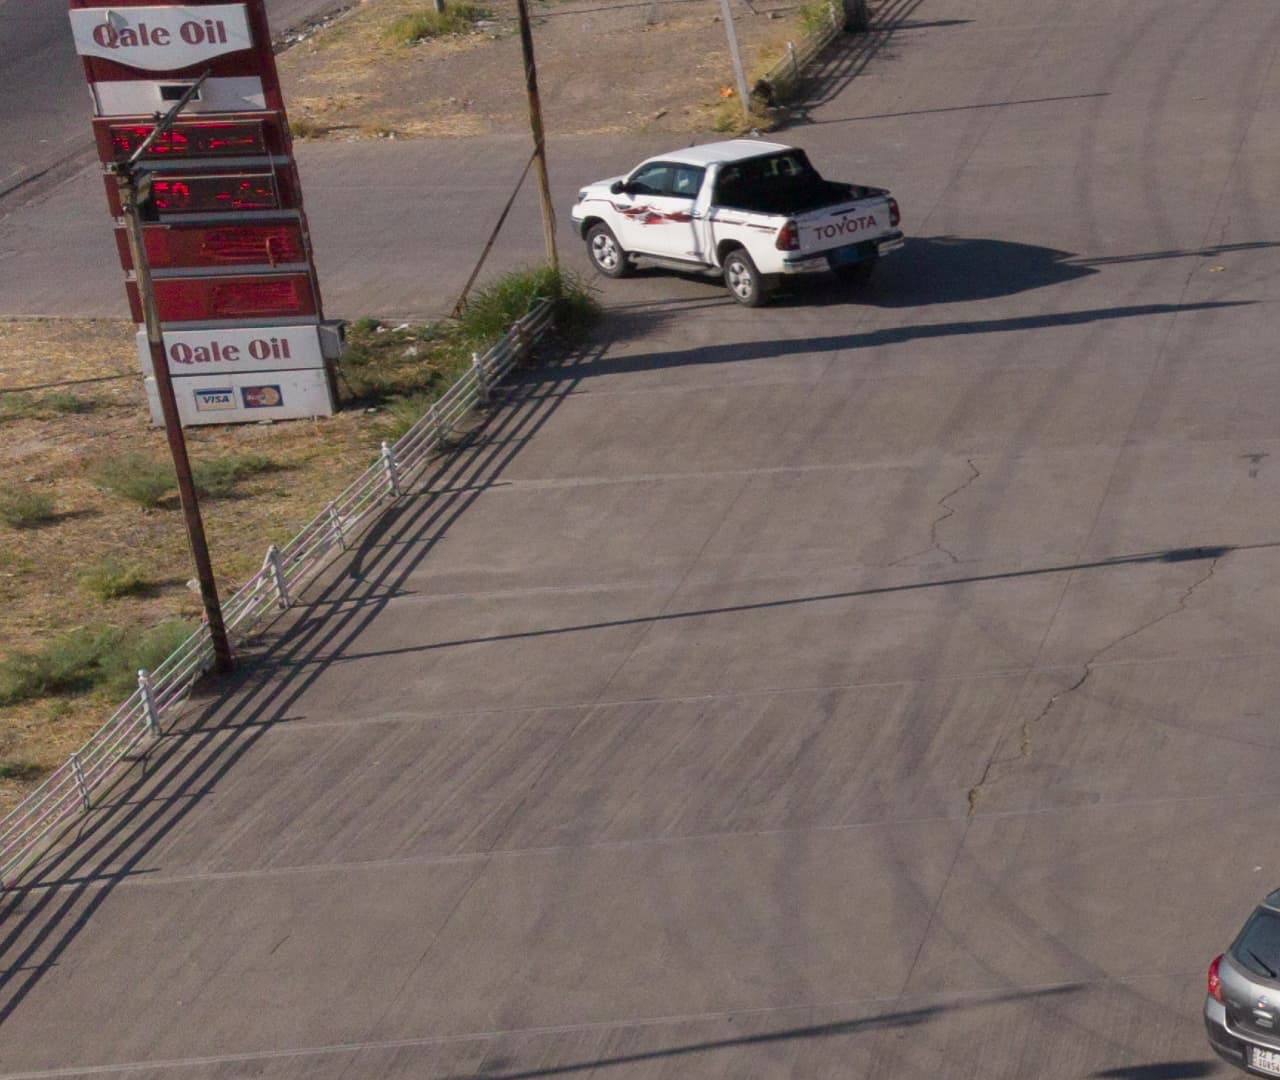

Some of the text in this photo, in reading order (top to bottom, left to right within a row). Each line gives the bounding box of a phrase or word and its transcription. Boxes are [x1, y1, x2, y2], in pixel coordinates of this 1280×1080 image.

[92, 19, 228, 49] Qale Oil
[813, 215, 877, 241] TOYOTA
[170, 337, 292, 365] Qale Oil
[202, 395, 230, 404] VISA
